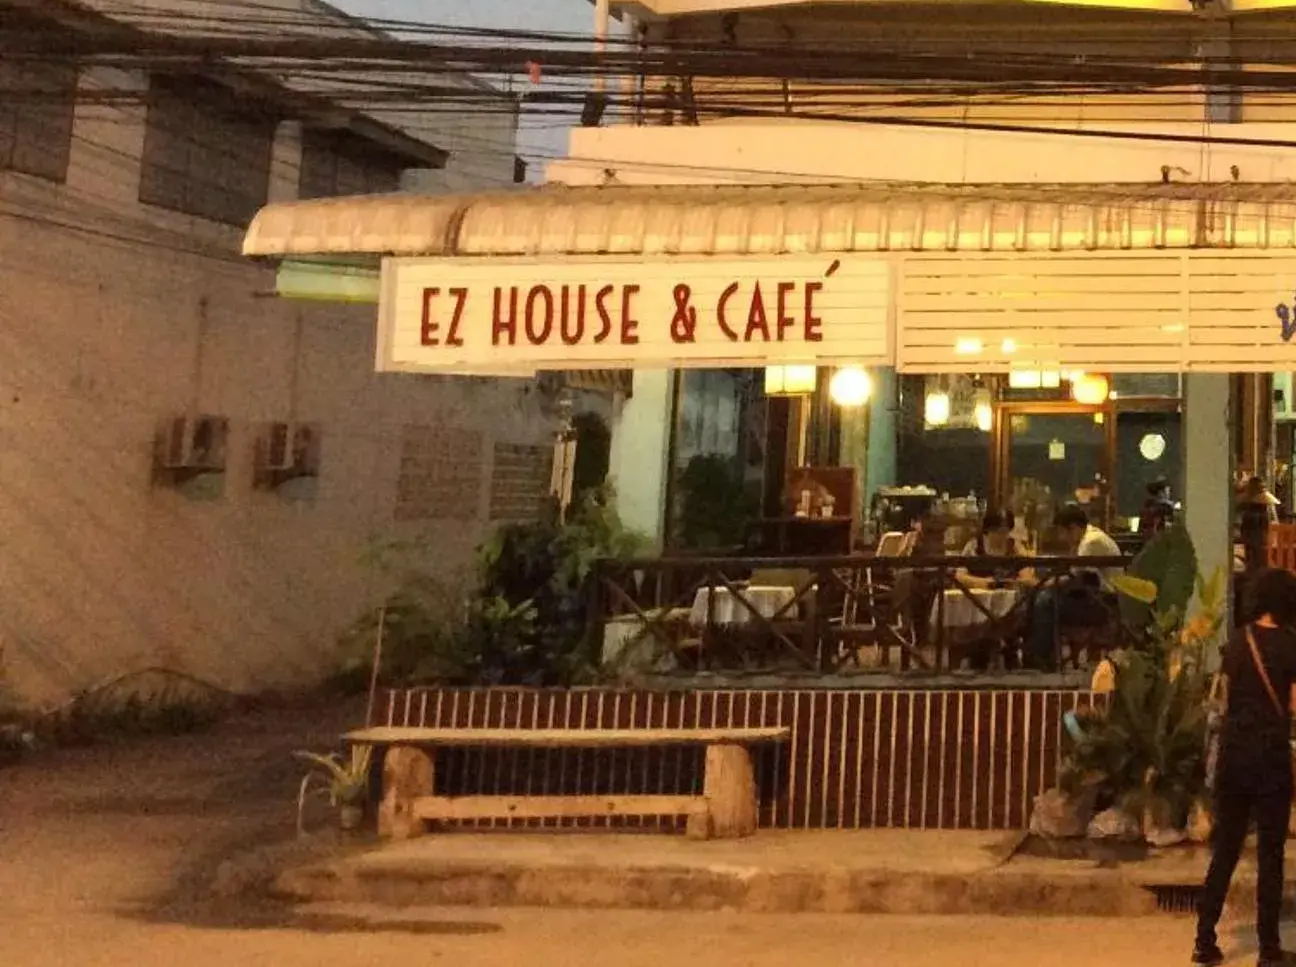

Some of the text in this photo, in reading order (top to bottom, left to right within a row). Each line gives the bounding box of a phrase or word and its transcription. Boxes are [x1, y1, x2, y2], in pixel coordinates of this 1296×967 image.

[420, 258, 842, 347] EZ HOUSE & CAFÉ
